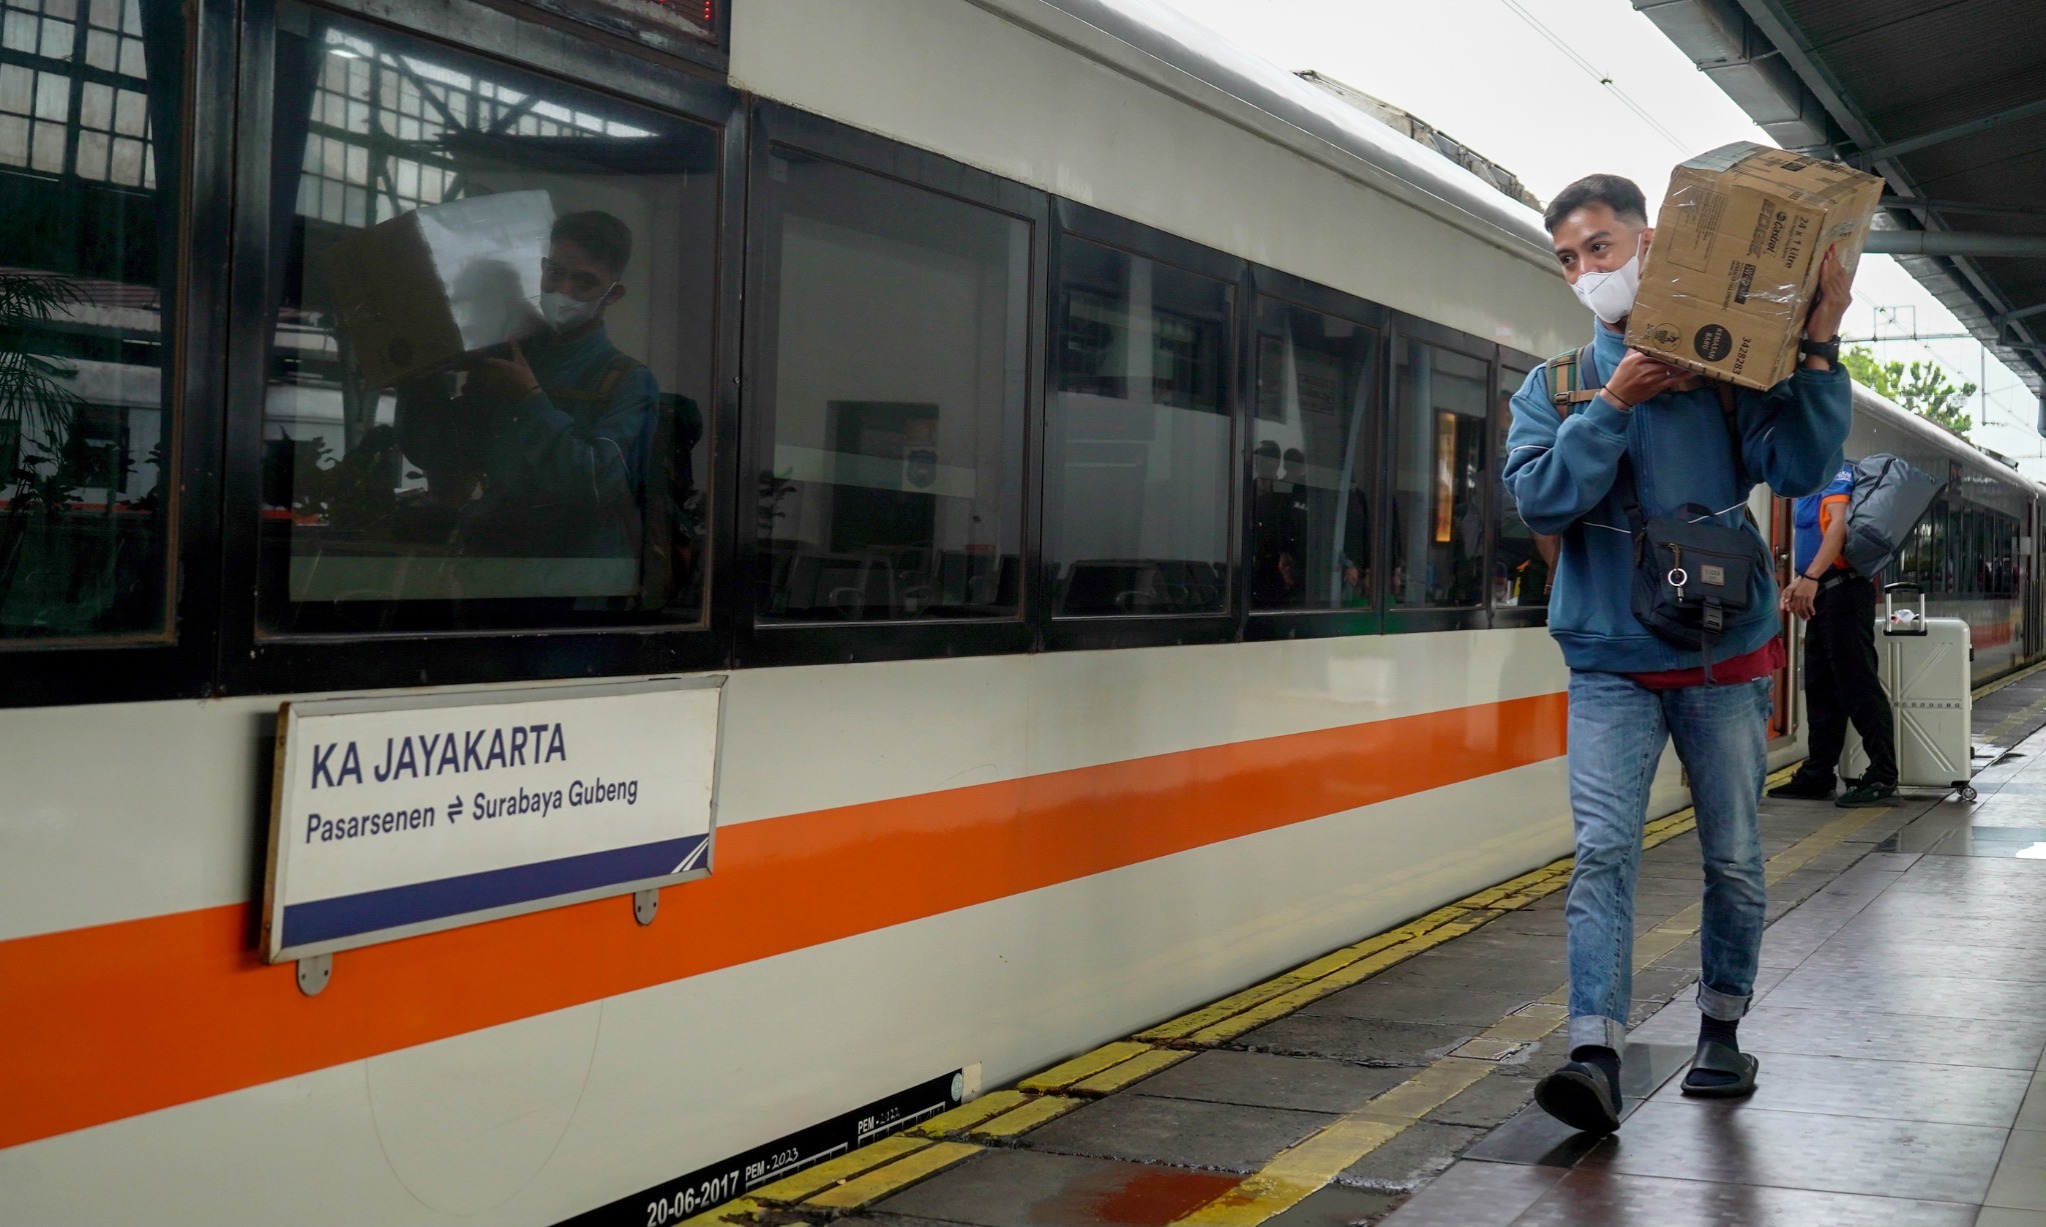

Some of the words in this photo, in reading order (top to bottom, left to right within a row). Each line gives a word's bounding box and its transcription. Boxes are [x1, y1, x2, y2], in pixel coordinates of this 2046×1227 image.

[1767, 221, 1783, 253] Castrol
[1798, 216, 1809, 229] 24
[1785, 247, 1799, 269] Litre
[1703, 332, 1713, 350] BARU
[1708, 328, 1723, 360] KEMASAN
[1733, 336, 1752, 375] 3428283
[311, 741, 363, 789] KA
[373, 723, 567, 783] JAYAKARTA
[305, 806, 435, 844] Pasarsenen
[472, 787, 562, 820] Surabaya
[568, 778, 639, 808] Gubeng
[857, 1115, 875, 1135] PEM
[745, 1161, 765, 1181] PEM
[771, 1147, 799, 1170] 2023
[646, 1170, 740, 1227] 20-06-2017
